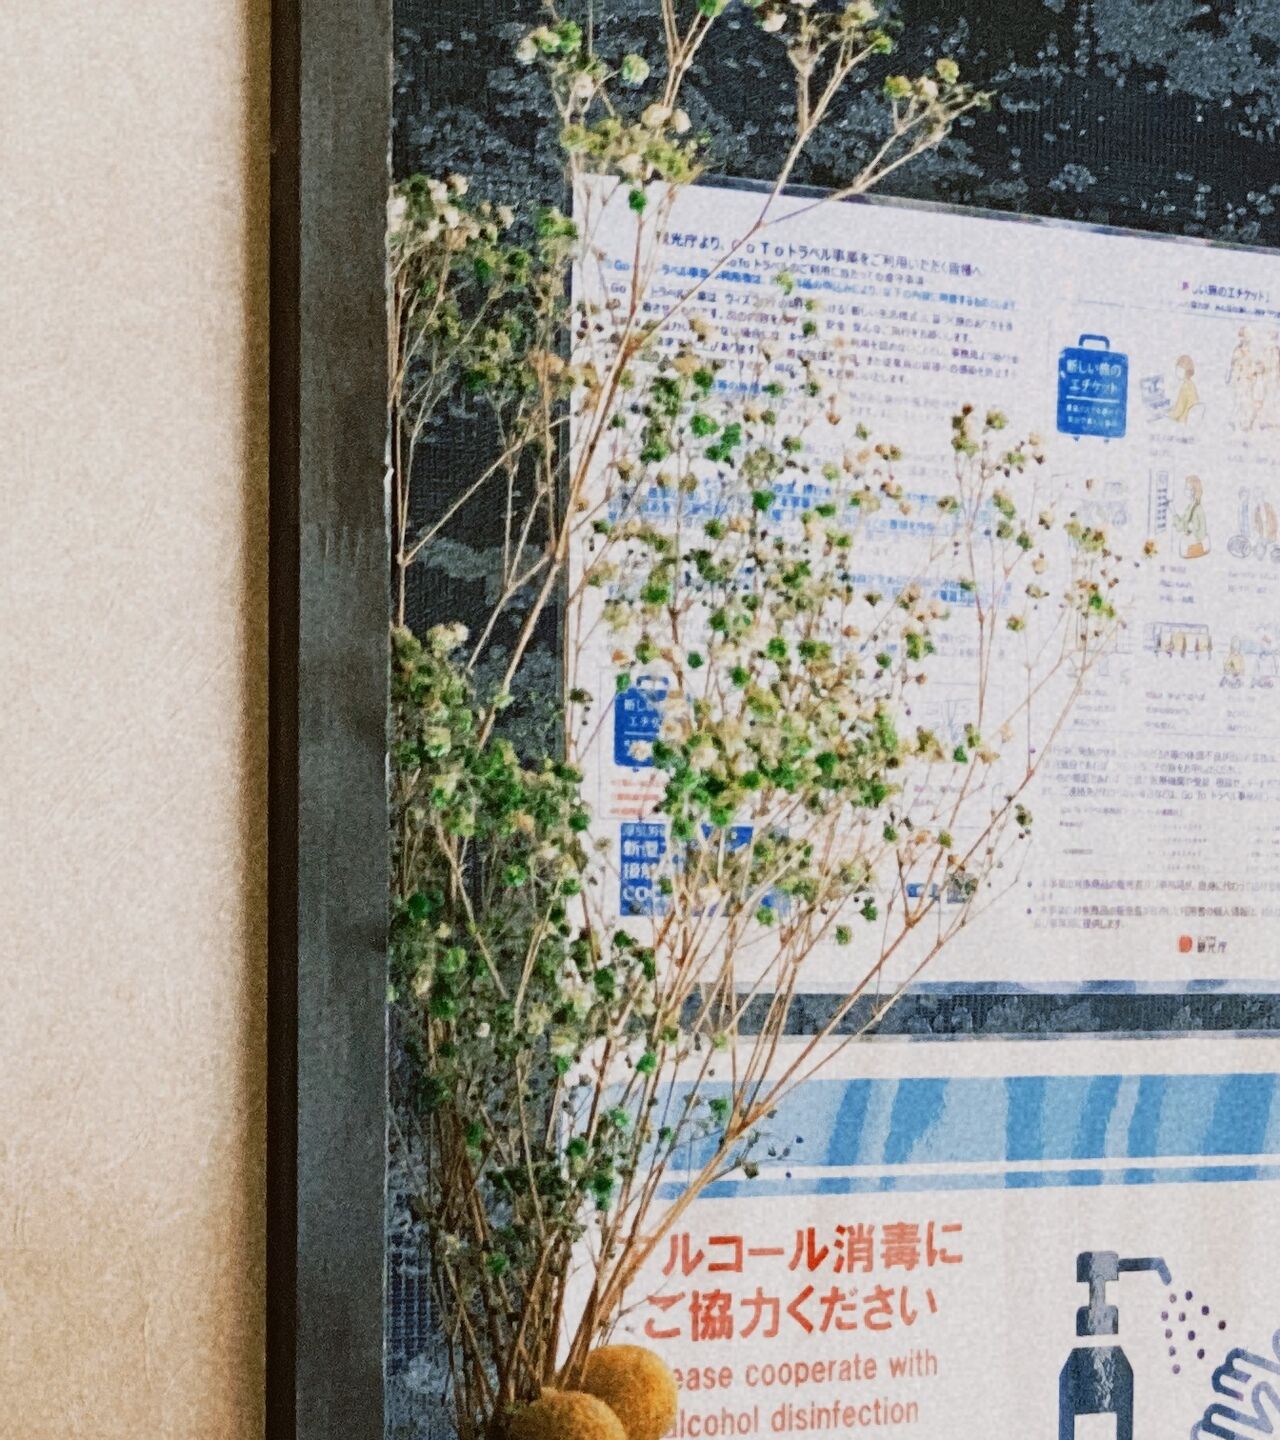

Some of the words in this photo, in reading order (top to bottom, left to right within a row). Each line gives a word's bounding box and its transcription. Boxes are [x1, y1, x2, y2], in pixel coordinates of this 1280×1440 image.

[644, 1283, 939, 1342] ご協力ください
[745, 1354, 878, 1391] cooperate
[889, 1348, 938, 1378] with
[771, 1400, 919, 1433] disinfection
